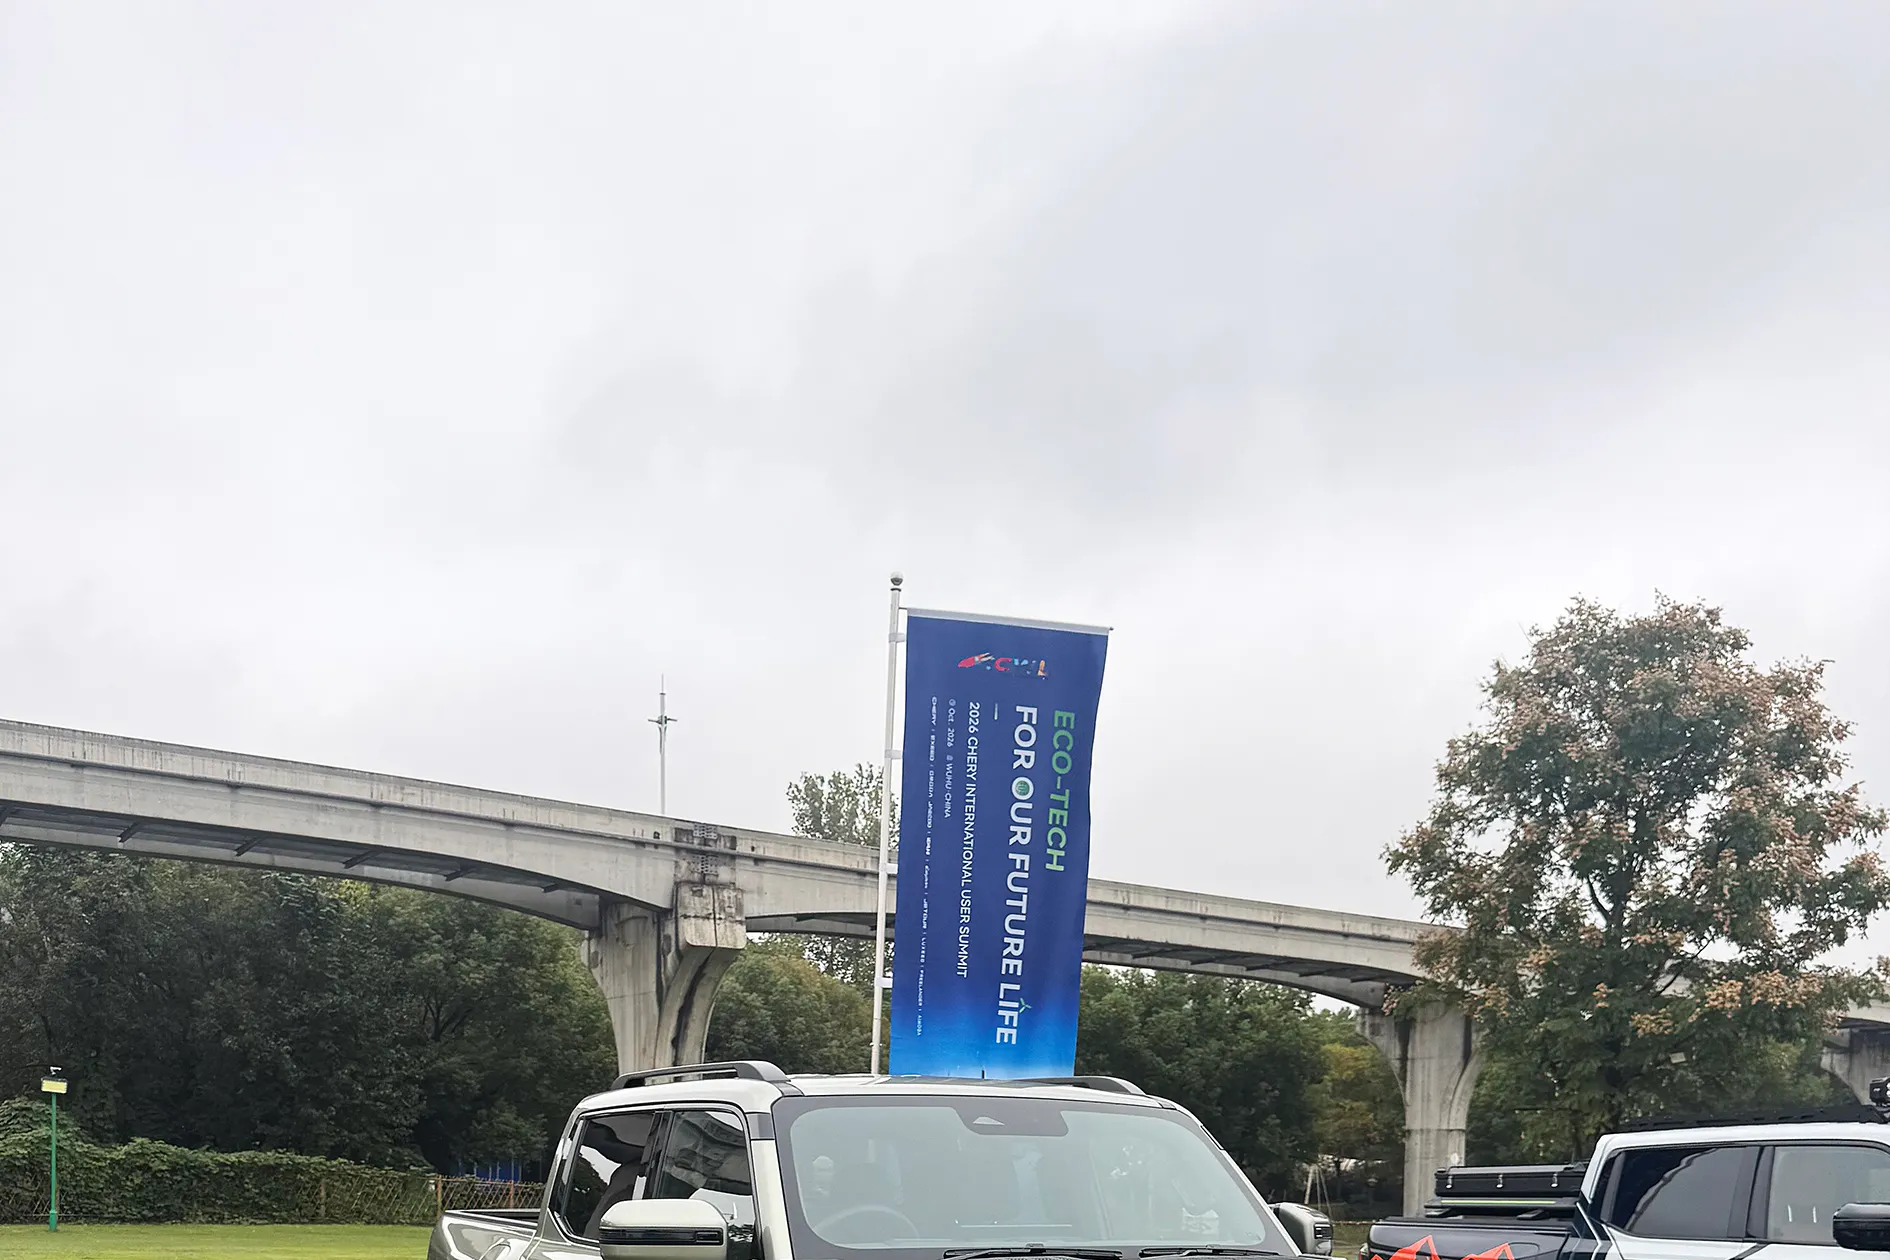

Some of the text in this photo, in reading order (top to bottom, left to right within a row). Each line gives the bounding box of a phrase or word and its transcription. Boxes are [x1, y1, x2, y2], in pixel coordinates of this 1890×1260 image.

[946, 727, 955, 748] 2026
[947, 707, 956, 725] Oct.
[1045, 709, 1076, 872] ECO-TECH
[956, 701, 981, 978] 2026 CHERY INTERNATIONAL USER SUMMIT
[995, 705, 1038, 1045] FOR OUR FUTURE LIFE
